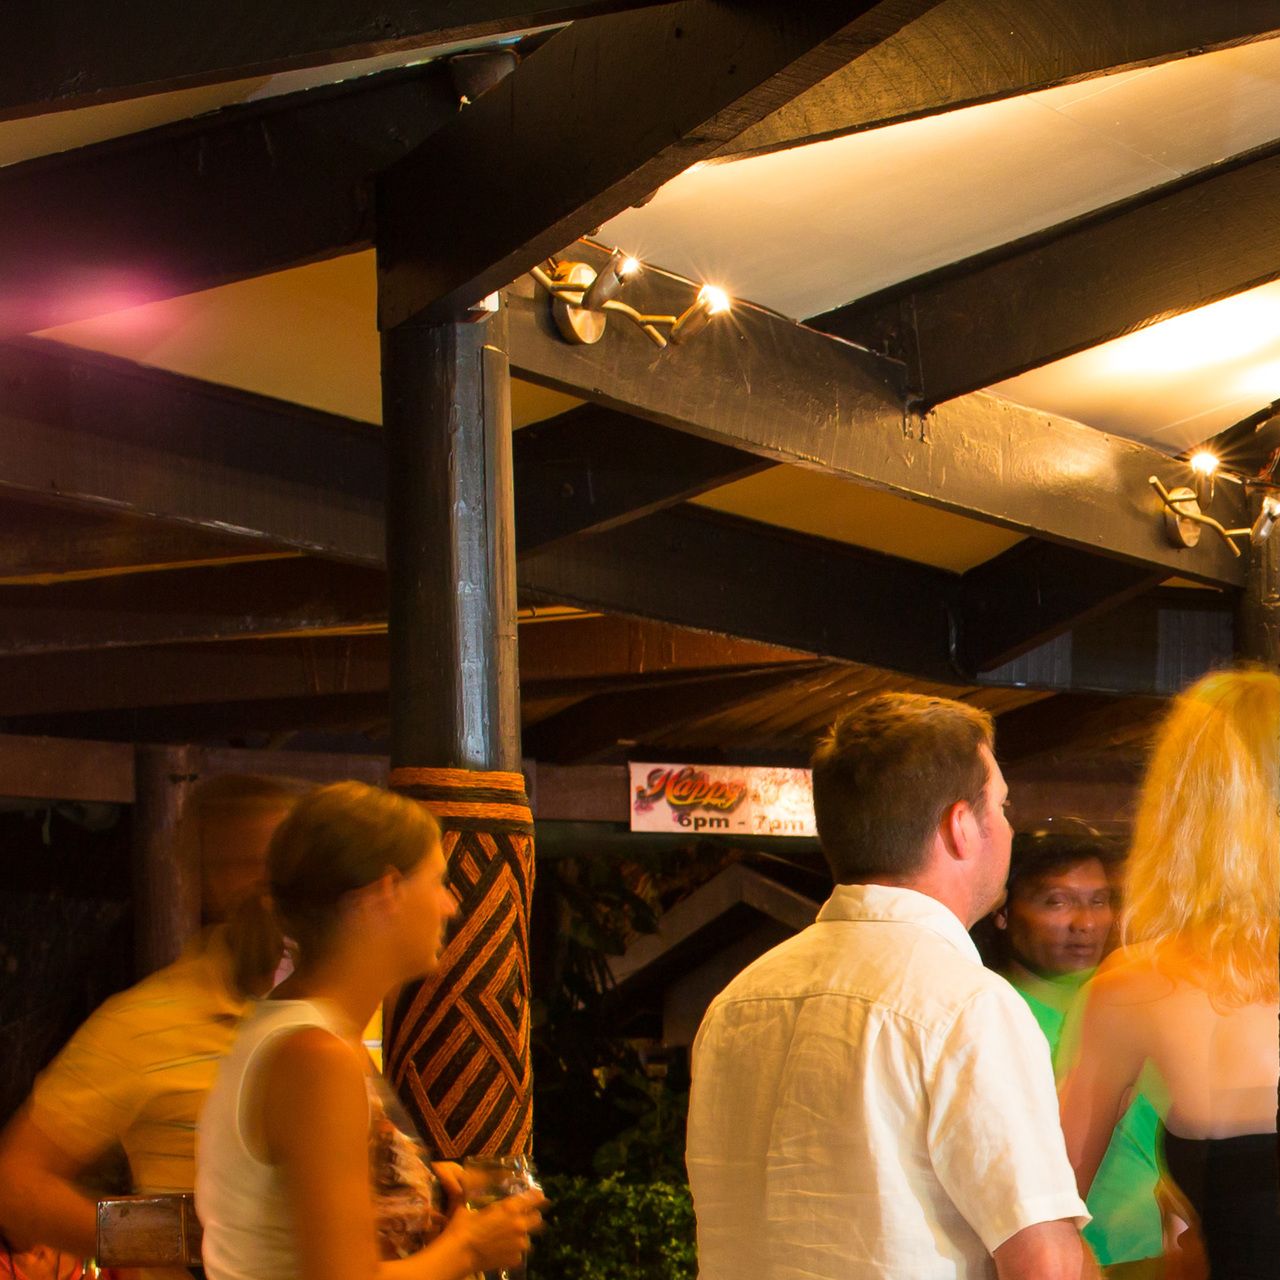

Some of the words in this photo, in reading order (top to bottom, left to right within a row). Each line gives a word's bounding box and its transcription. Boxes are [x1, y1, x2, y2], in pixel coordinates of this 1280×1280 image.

[634, 767, 748, 812] Happy
[678, 814, 730, 831] 6pm
[752, 815, 804, 833] 7pm
